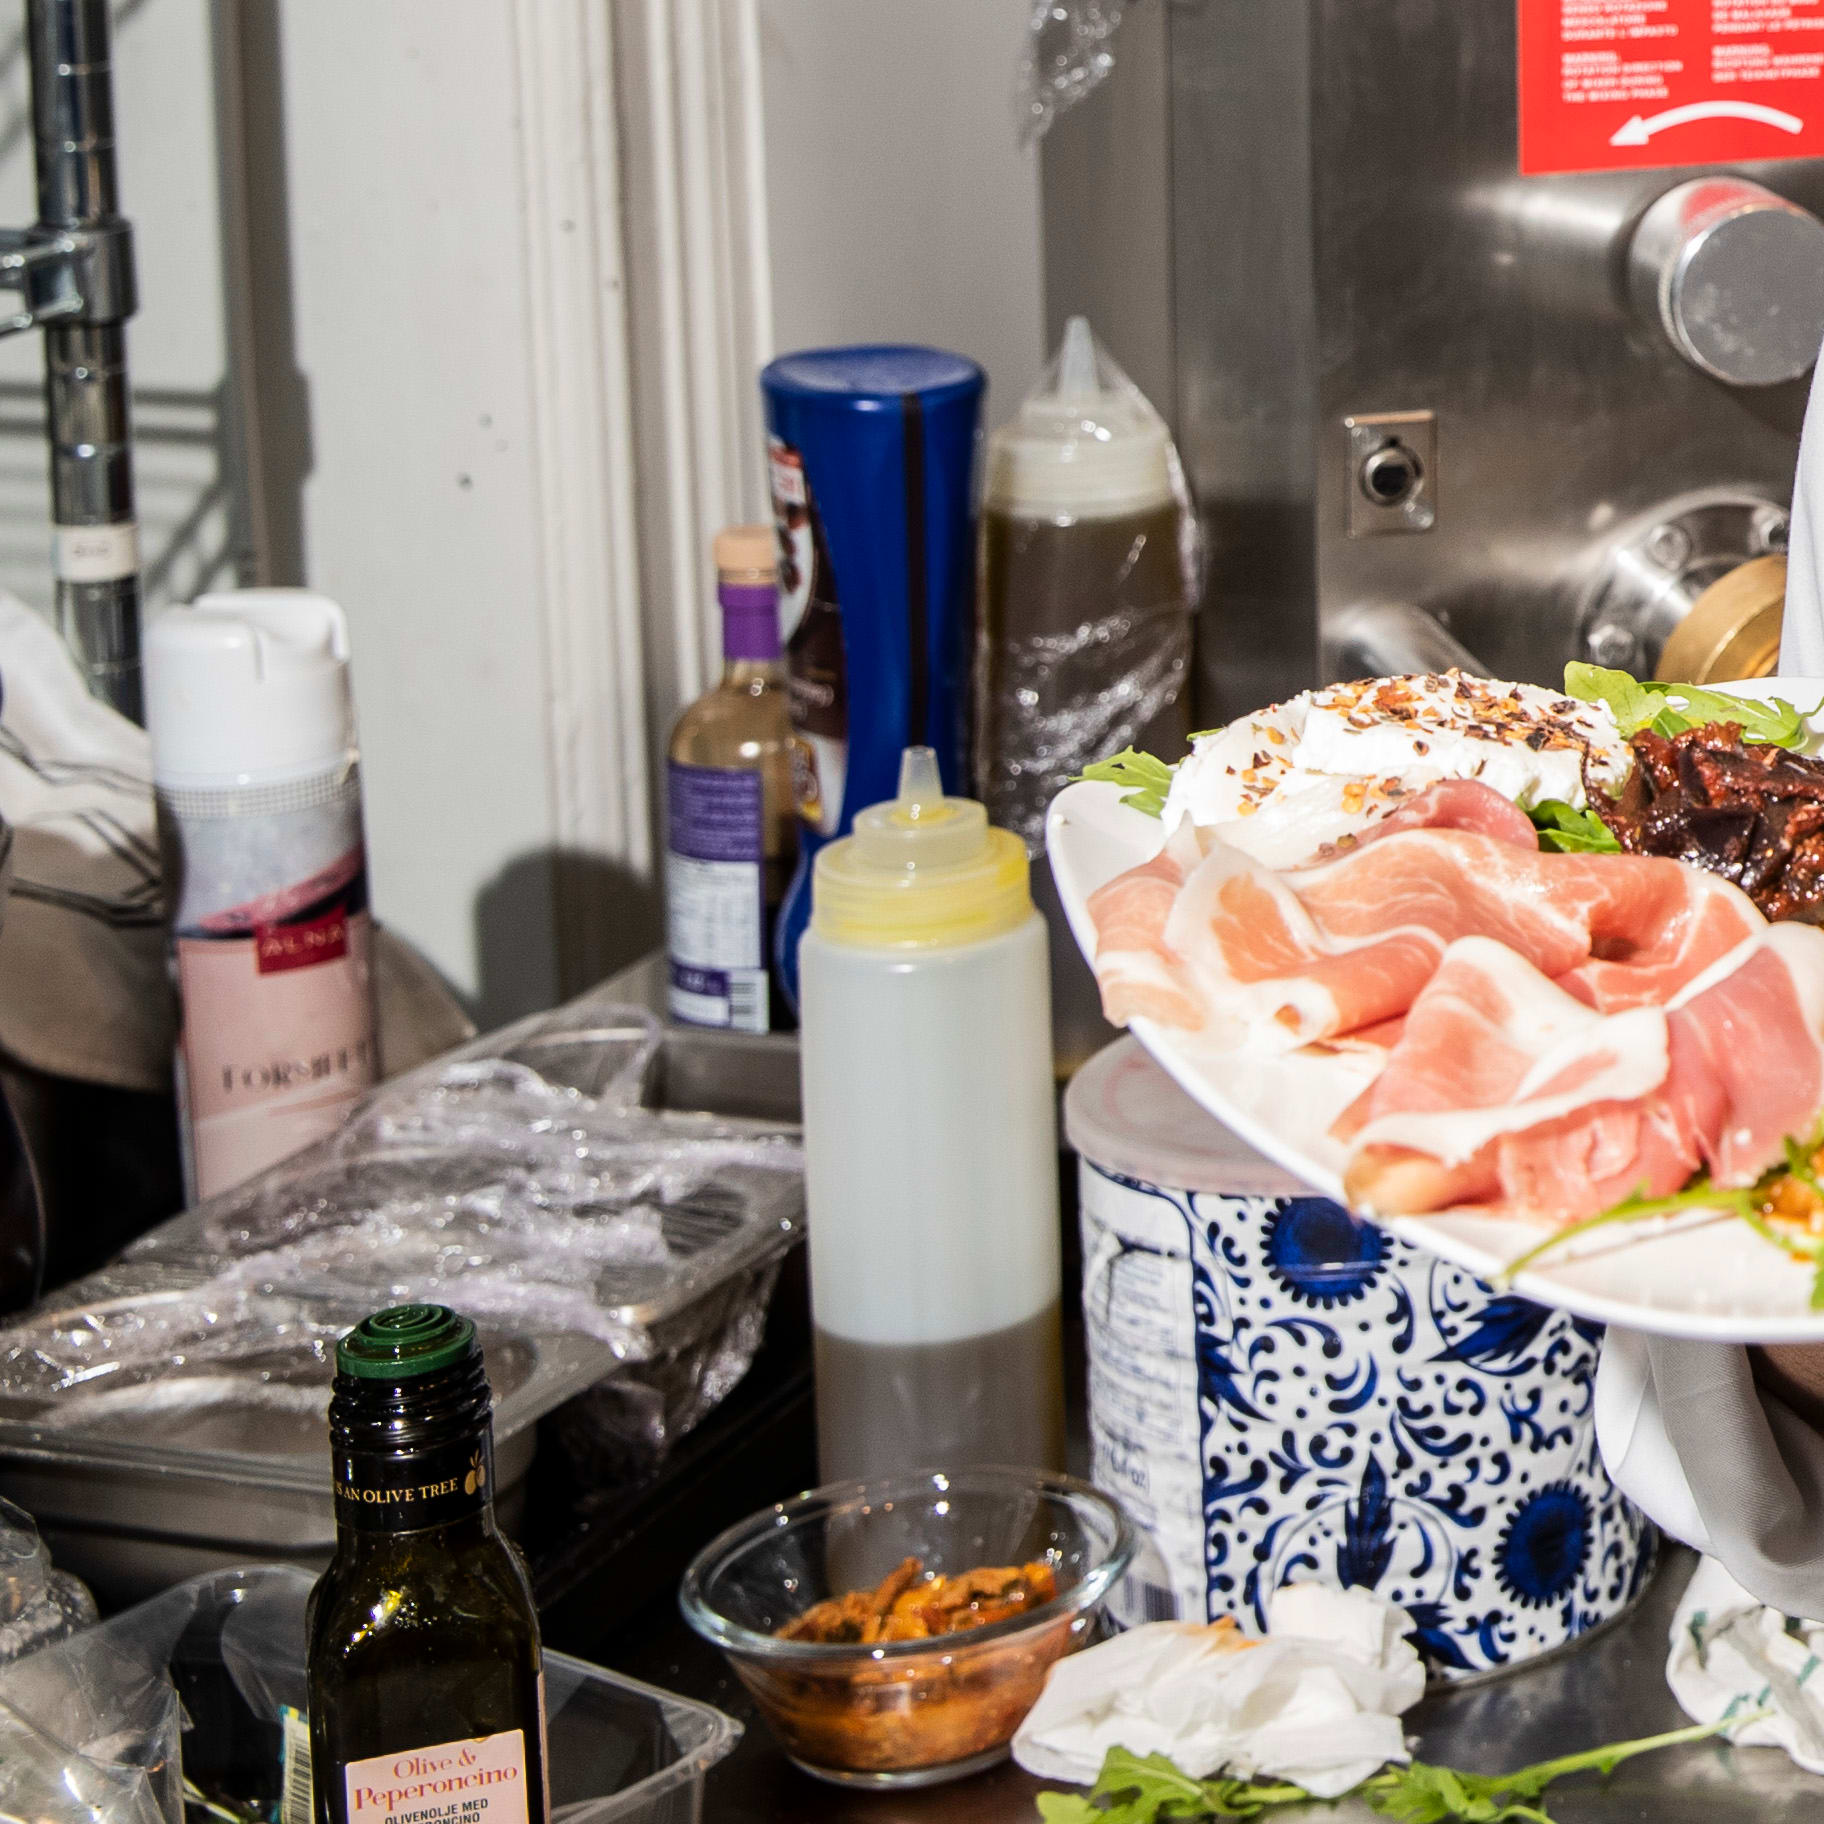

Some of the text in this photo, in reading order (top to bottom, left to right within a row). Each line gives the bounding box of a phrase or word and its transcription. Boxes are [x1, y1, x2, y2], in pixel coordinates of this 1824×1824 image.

[344, 1487, 361, 1502] AN
[363, 1488, 415, 1505] OLIVE
[418, 1477, 459, 1500] TREE
[393, 1746, 477, 1780] Olive &
[354, 1764, 519, 1813] Peperoncino
[384, 1797, 488, 1824] OLIVENOLJE MED
